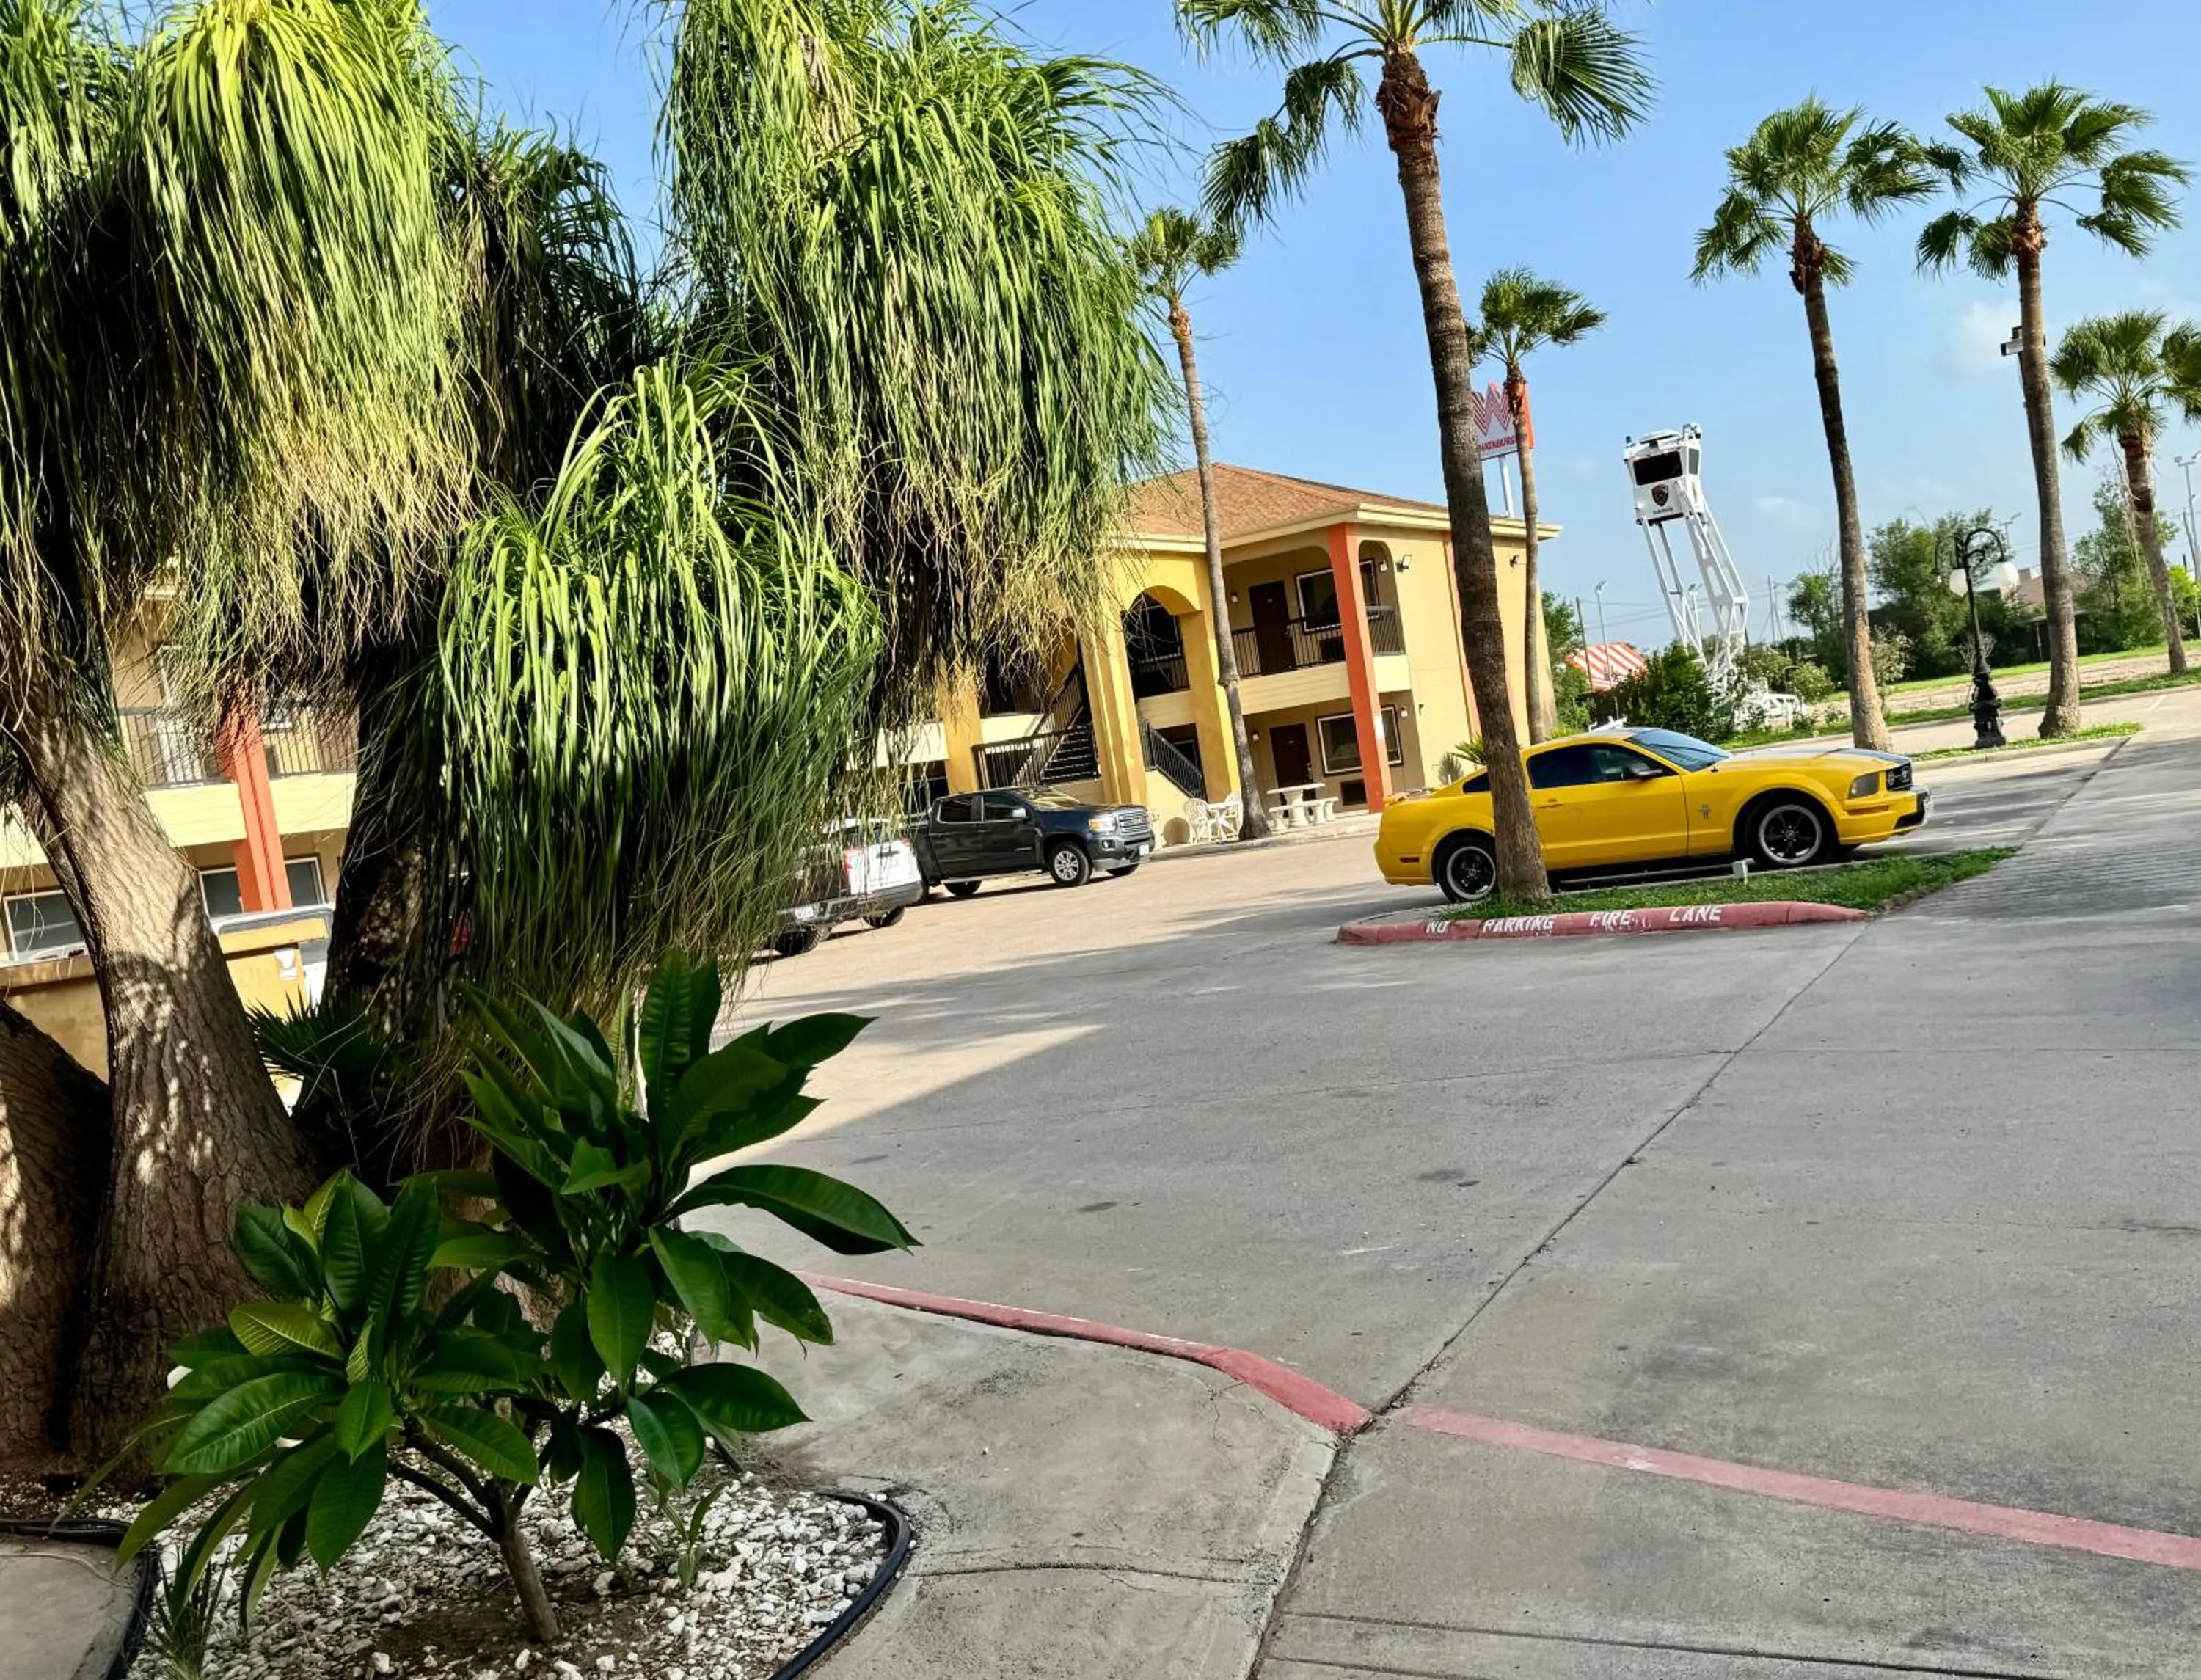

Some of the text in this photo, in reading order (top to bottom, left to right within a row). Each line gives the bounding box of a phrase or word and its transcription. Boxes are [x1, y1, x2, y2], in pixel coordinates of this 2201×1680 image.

[1426, 905, 1723, 934] NO PARKING FIRE LANE
